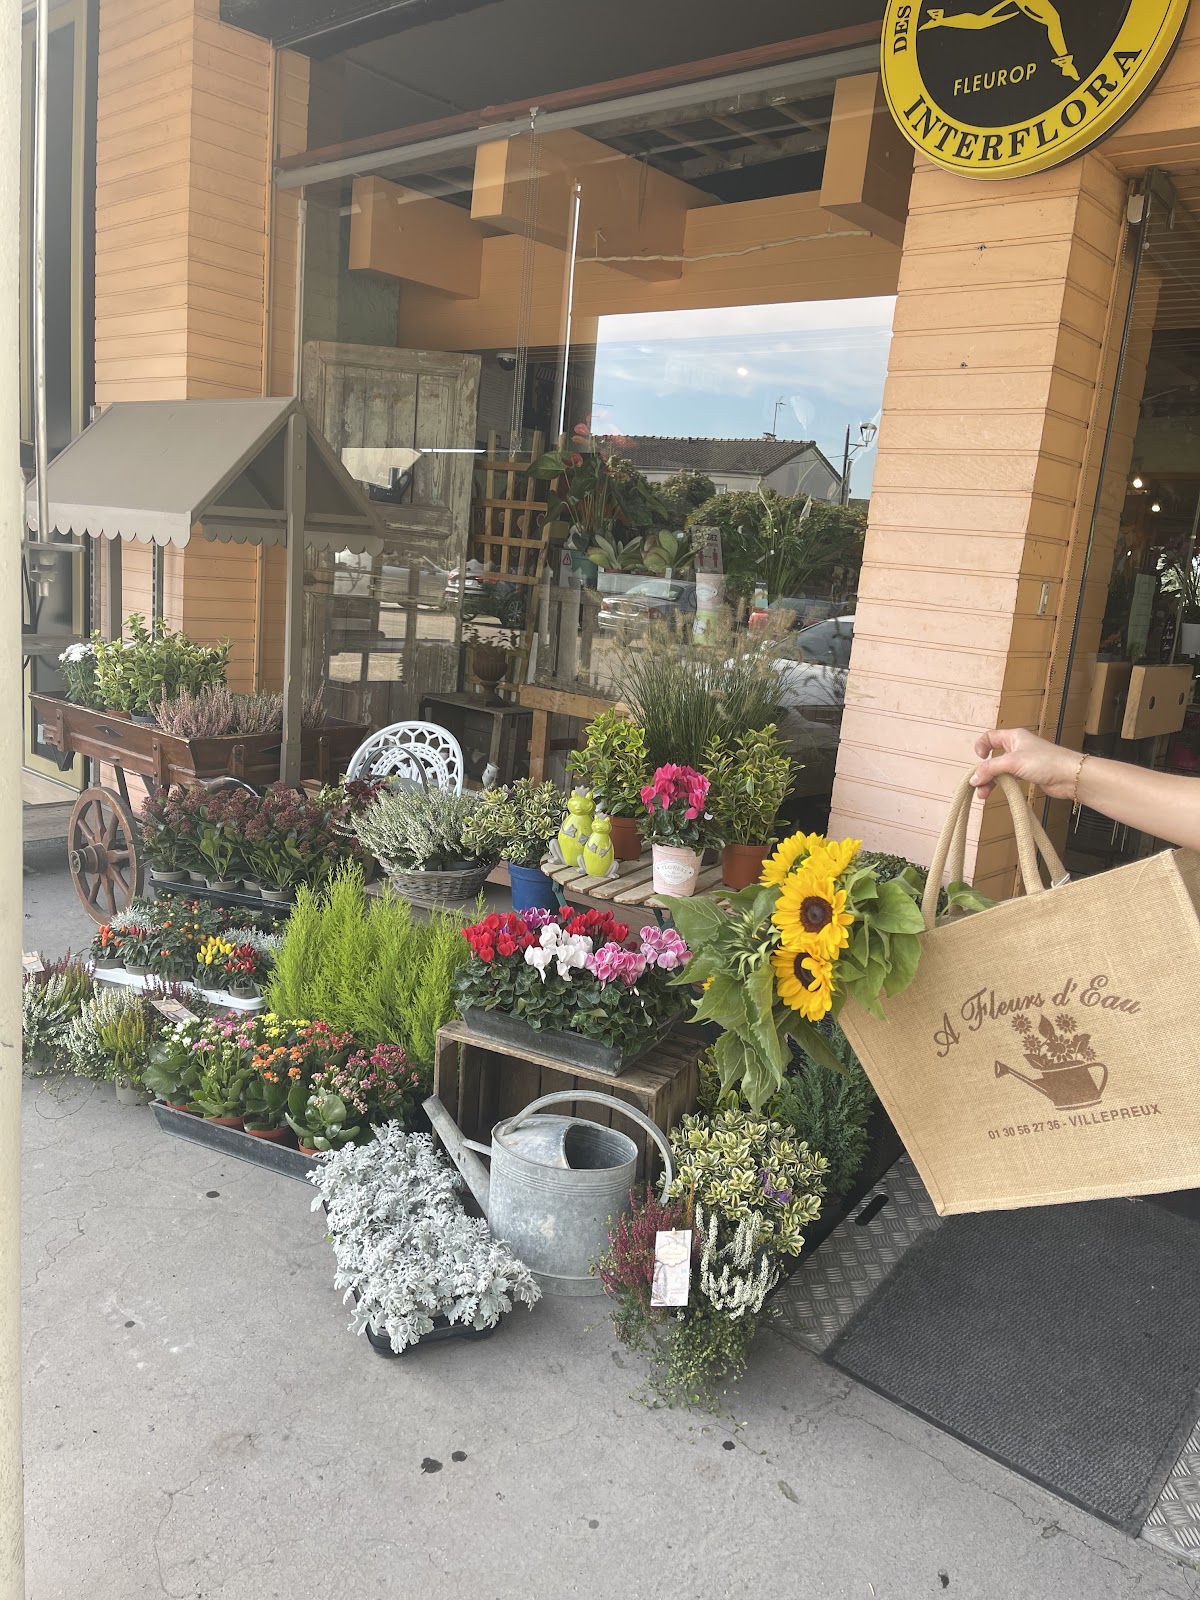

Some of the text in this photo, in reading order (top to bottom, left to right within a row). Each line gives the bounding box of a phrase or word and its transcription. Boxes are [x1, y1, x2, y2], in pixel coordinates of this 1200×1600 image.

[893, 5, 912, 55] DES
[953, 62, 1037, 96] FLEUROP
[903, 48, 1142, 162] INTERFLORA
[933, 1012, 960, 1058] A
[961, 987, 1045, 1032] Fleurs
[988, 1130, 1000, 1140] 01
[1003, 1127, 1016, 1138] 30
[1017, 1124, 1031, 1136] 56
[1032, 1122, 1045, 1133] 27
[1048, 1119, 1061, 1131] 36
[1069, 1103, 1162, 1127] VILLEPREUX
